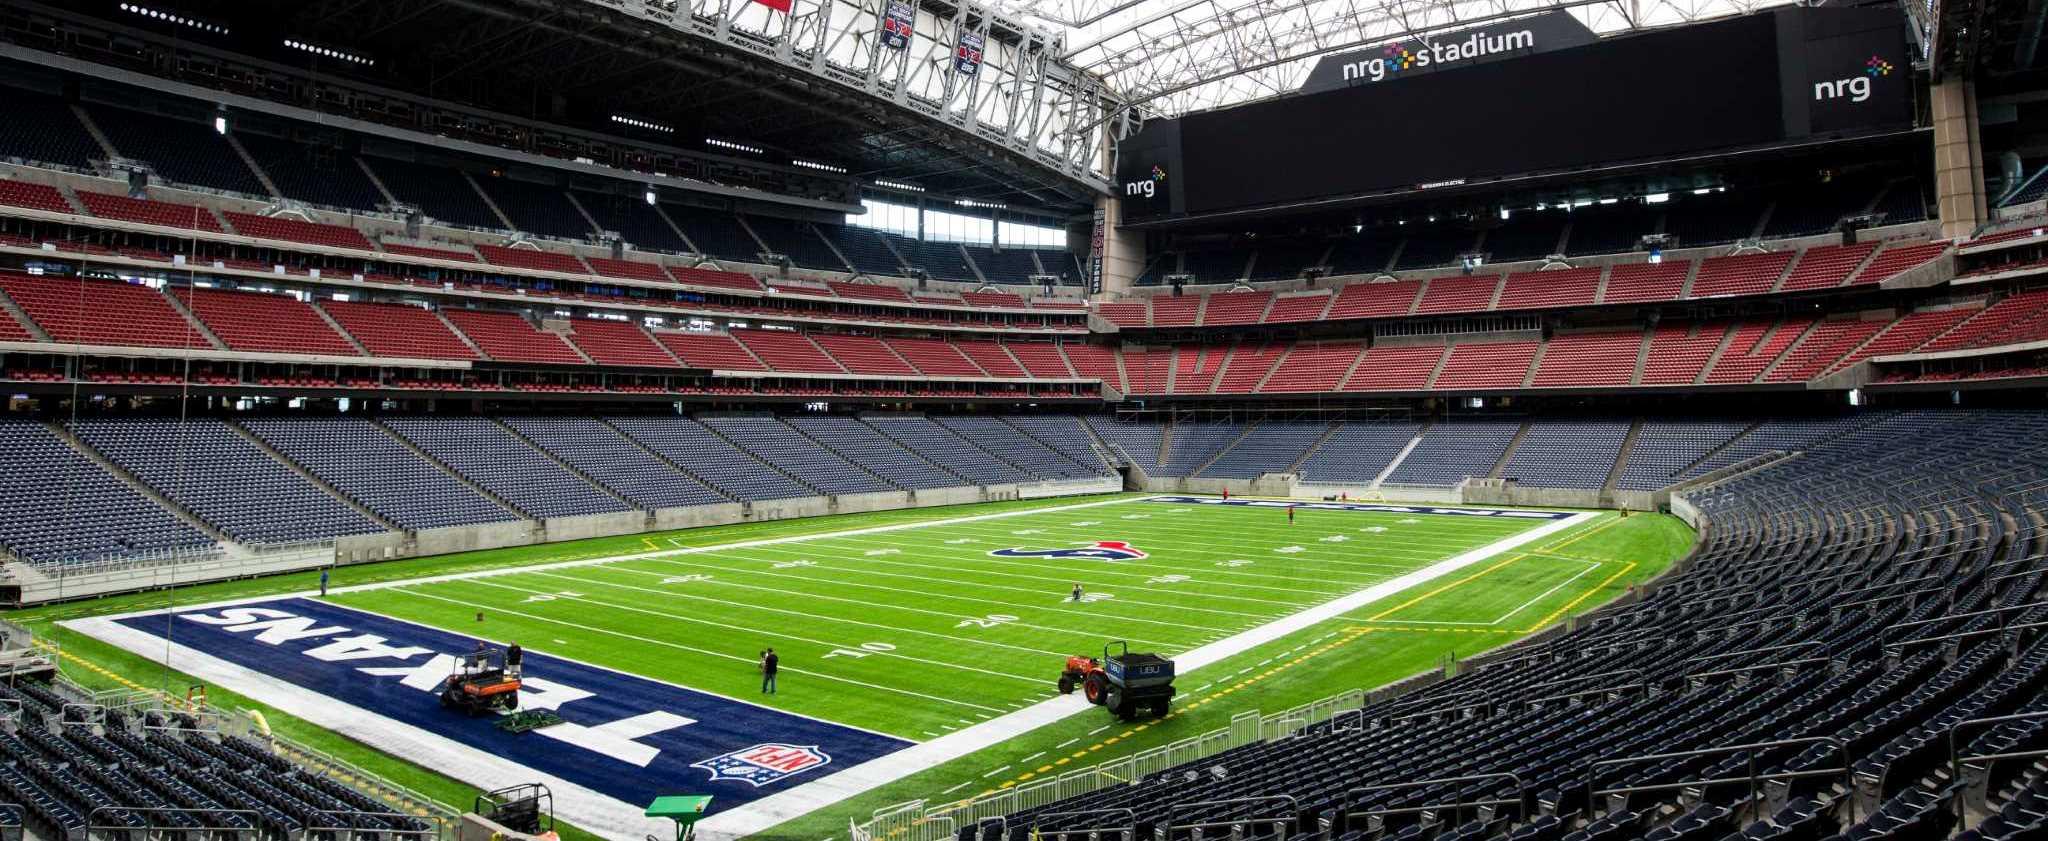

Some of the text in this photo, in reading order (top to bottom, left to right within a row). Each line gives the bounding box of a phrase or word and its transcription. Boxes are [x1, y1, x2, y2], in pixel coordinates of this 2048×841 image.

[1343, 29, 1534, 82] nrg stadium
[1815, 76, 1871, 102] nrg
[1127, 180, 1155, 198] nrg
[954, 614, 1020, 629] 20
[821, 642, 897, 659] 10
[178, 607, 698, 767] TEXANS
[745, 747, 819, 771] NFL
